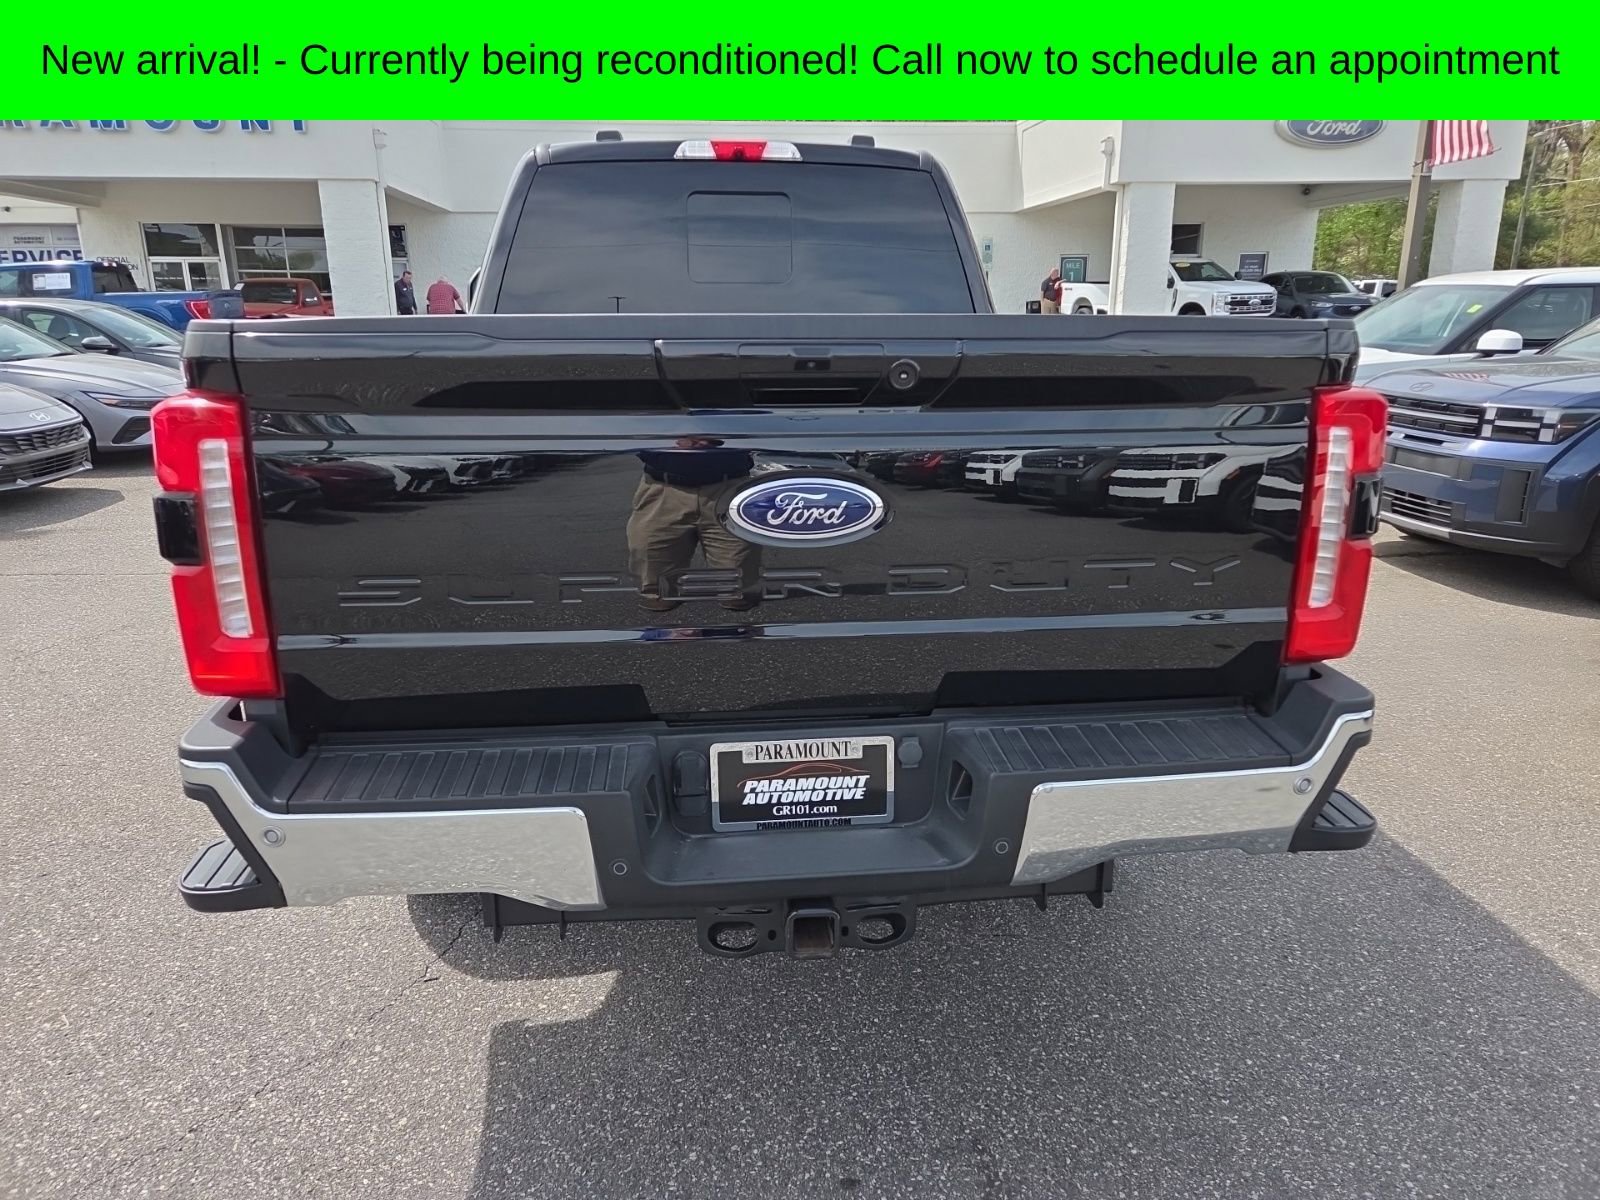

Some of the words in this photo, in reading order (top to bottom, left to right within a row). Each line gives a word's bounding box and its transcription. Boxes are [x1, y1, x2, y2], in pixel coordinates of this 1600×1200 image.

[1306, 119, 1362, 136] Ford
[766, 492, 845, 526] Ford
[337, 566, 843, 606] SUPER
[888, 554, 1241, 596] DUTY
[755, 741, 852, 760] PARAMOUNT
[743, 775, 870, 793] PARAMOUNT
[742, 788, 866, 805] AUTOMOTIVE
[773, 804, 838, 816] GR101.com
[756, 818, 852, 831] PARAMOUNTAUTO.COM
